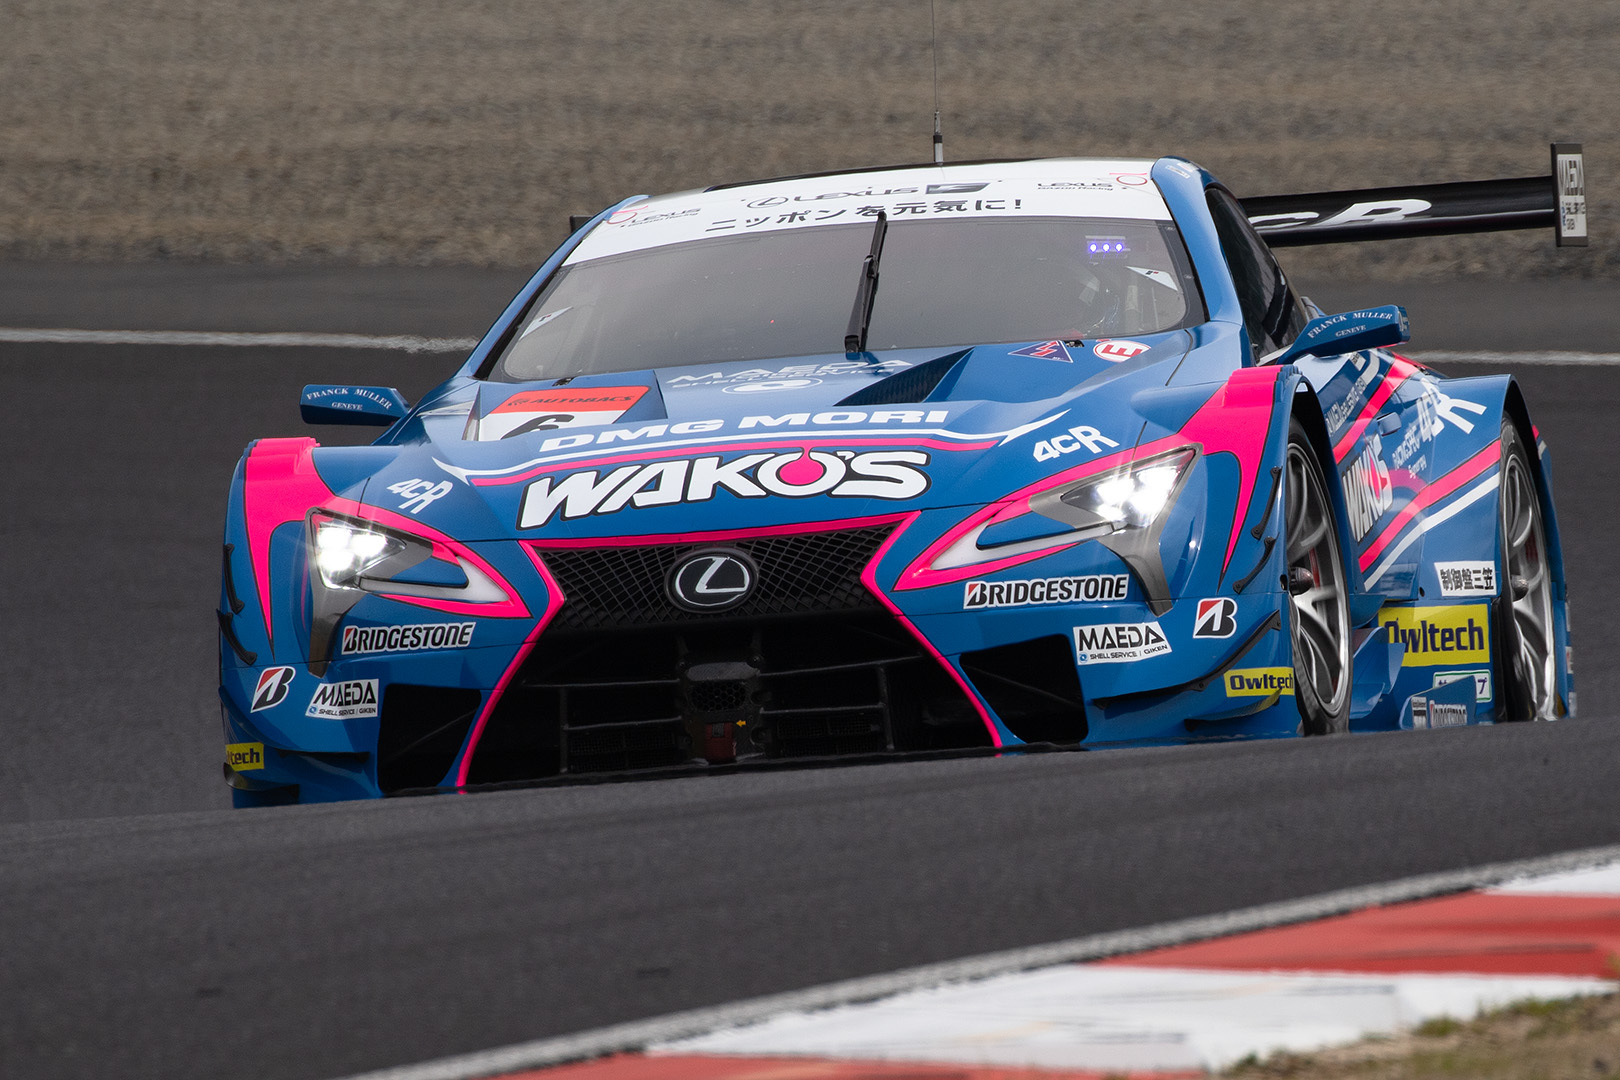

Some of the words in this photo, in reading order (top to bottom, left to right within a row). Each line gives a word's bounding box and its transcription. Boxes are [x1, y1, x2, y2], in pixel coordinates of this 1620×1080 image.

[794, 186, 918, 202] LEXUS
[1307, 315, 1347, 339] FRANCK
[1352, 312, 1393, 320] MULLER
[1335, 325, 1367, 337] GENEVE
[666, 359, 913, 384] MAEDA
[306, 388, 349, 400] FRANCK
[353, 388, 393, 410] MULLER
[331, 402, 363, 411] GENEVE
[530, 395, 635, 404] AUTOBACS
[539, 419, 725, 453] DMG
[738, 410, 949, 428] MORI
[1033, 425, 1120, 463] 4CR
[386, 478, 454, 515] 4CR
[517, 447, 931, 530] WAKO'S
[965, 575, 1128, 607] BRIDGESTONE
[342, 624, 475, 654] BRIDGESTONE
[1079, 624, 1166, 652] MAEDA
[1385, 617, 1485, 654] Owltech
[1143, 643, 1169, 655] GIKEN
[312, 681, 377, 707] MAEDA
[1230, 673, 1294, 690] Owltech
[359, 707, 376, 715] GIKEN
